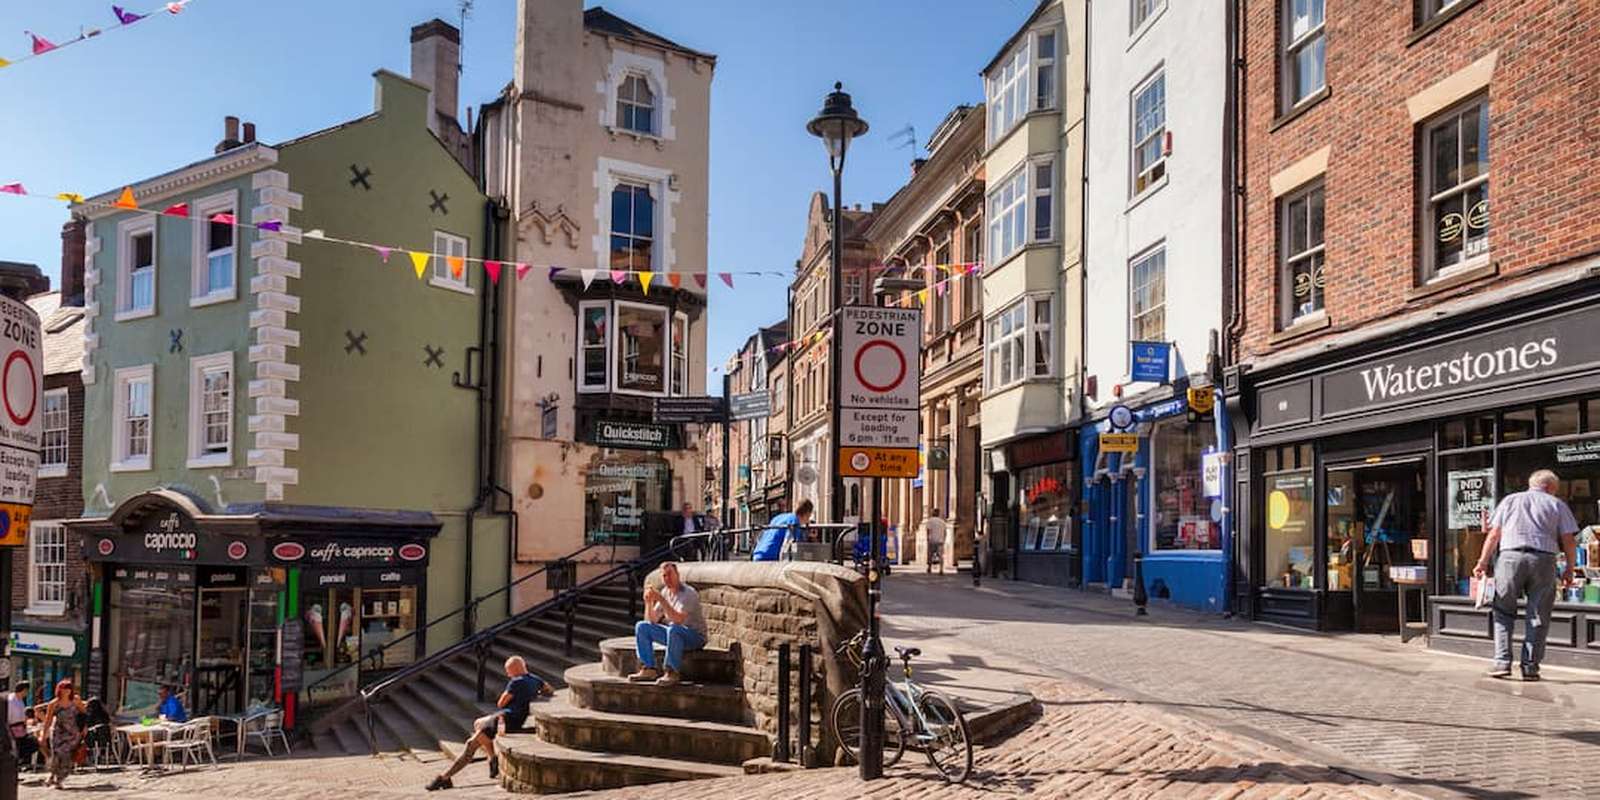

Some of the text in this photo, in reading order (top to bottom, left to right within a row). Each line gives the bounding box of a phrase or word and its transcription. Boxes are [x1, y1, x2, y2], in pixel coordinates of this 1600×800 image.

[0, 301, 40, 330] EDESTRIAN
[846, 310, 916, 322] PEDESTRIAN
[3, 318, 36, 349] ZONE
[855, 321, 906, 337] ZONE
[1360, 337, 1559, 401] Waterstones
[851, 393, 910, 405] No vehicles
[853, 412, 906, 424] Except for
[603, 425, 663, 442] Quickstitch
[860, 421, 898, 434] loading
[874, 451, 907, 465] At any
[880, 462, 903, 472] time
[1459, 479, 1483, 490] INTO
[1462, 490, 1481, 501] THE
[144, 532, 197, 553] capriccio
[342, 546, 394, 559] capriccio
